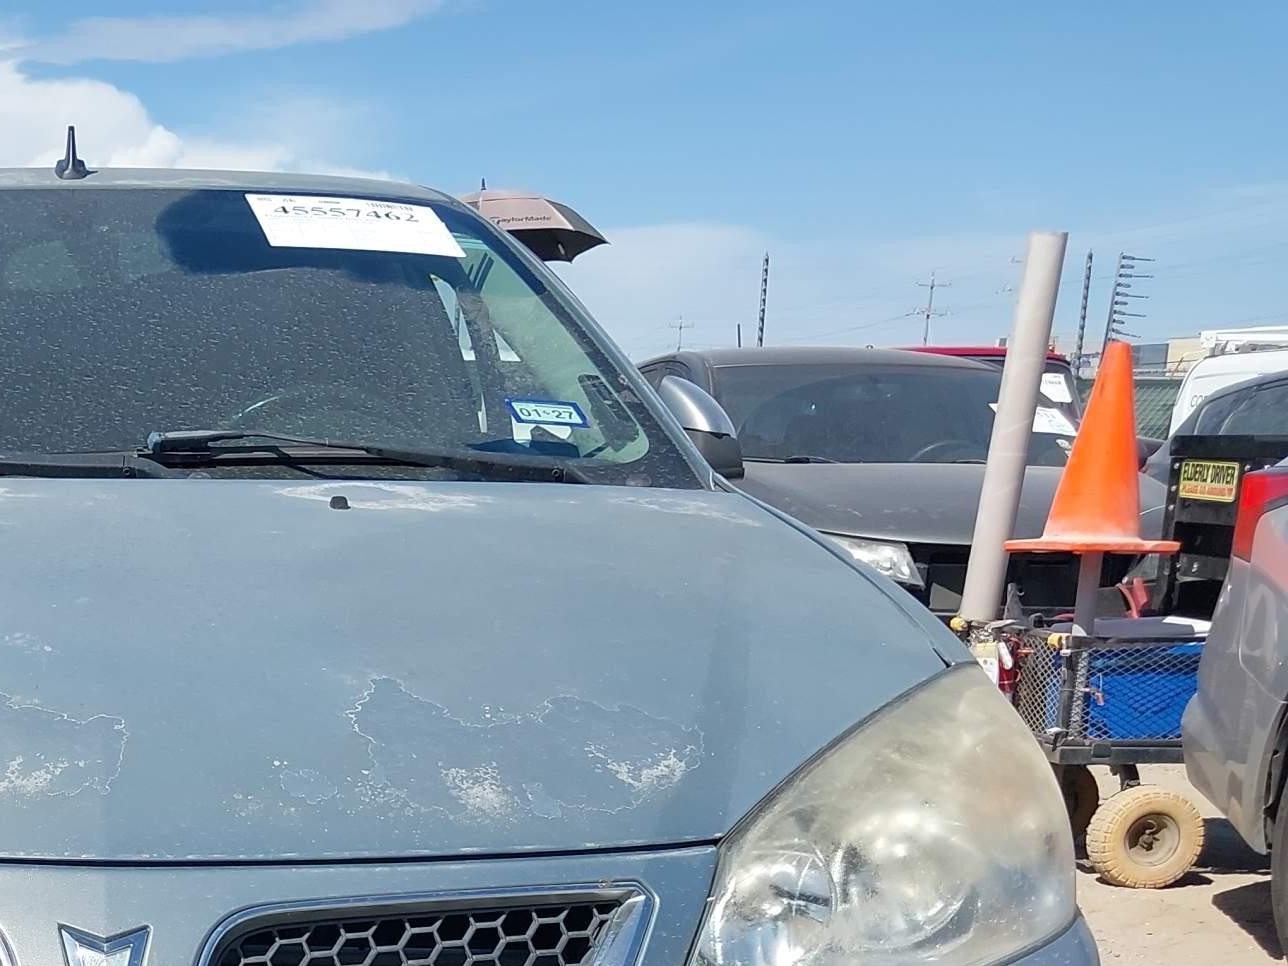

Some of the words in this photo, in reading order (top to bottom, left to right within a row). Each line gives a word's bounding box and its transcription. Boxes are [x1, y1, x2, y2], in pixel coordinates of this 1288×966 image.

[274, 205, 420, 223] 45557462
[519, 407, 542, 418] 01
[552, 409, 573, 420] 27
[1183, 463, 1211, 483] ELDERLY
[1210, 464, 1236, 486] DRIVER
